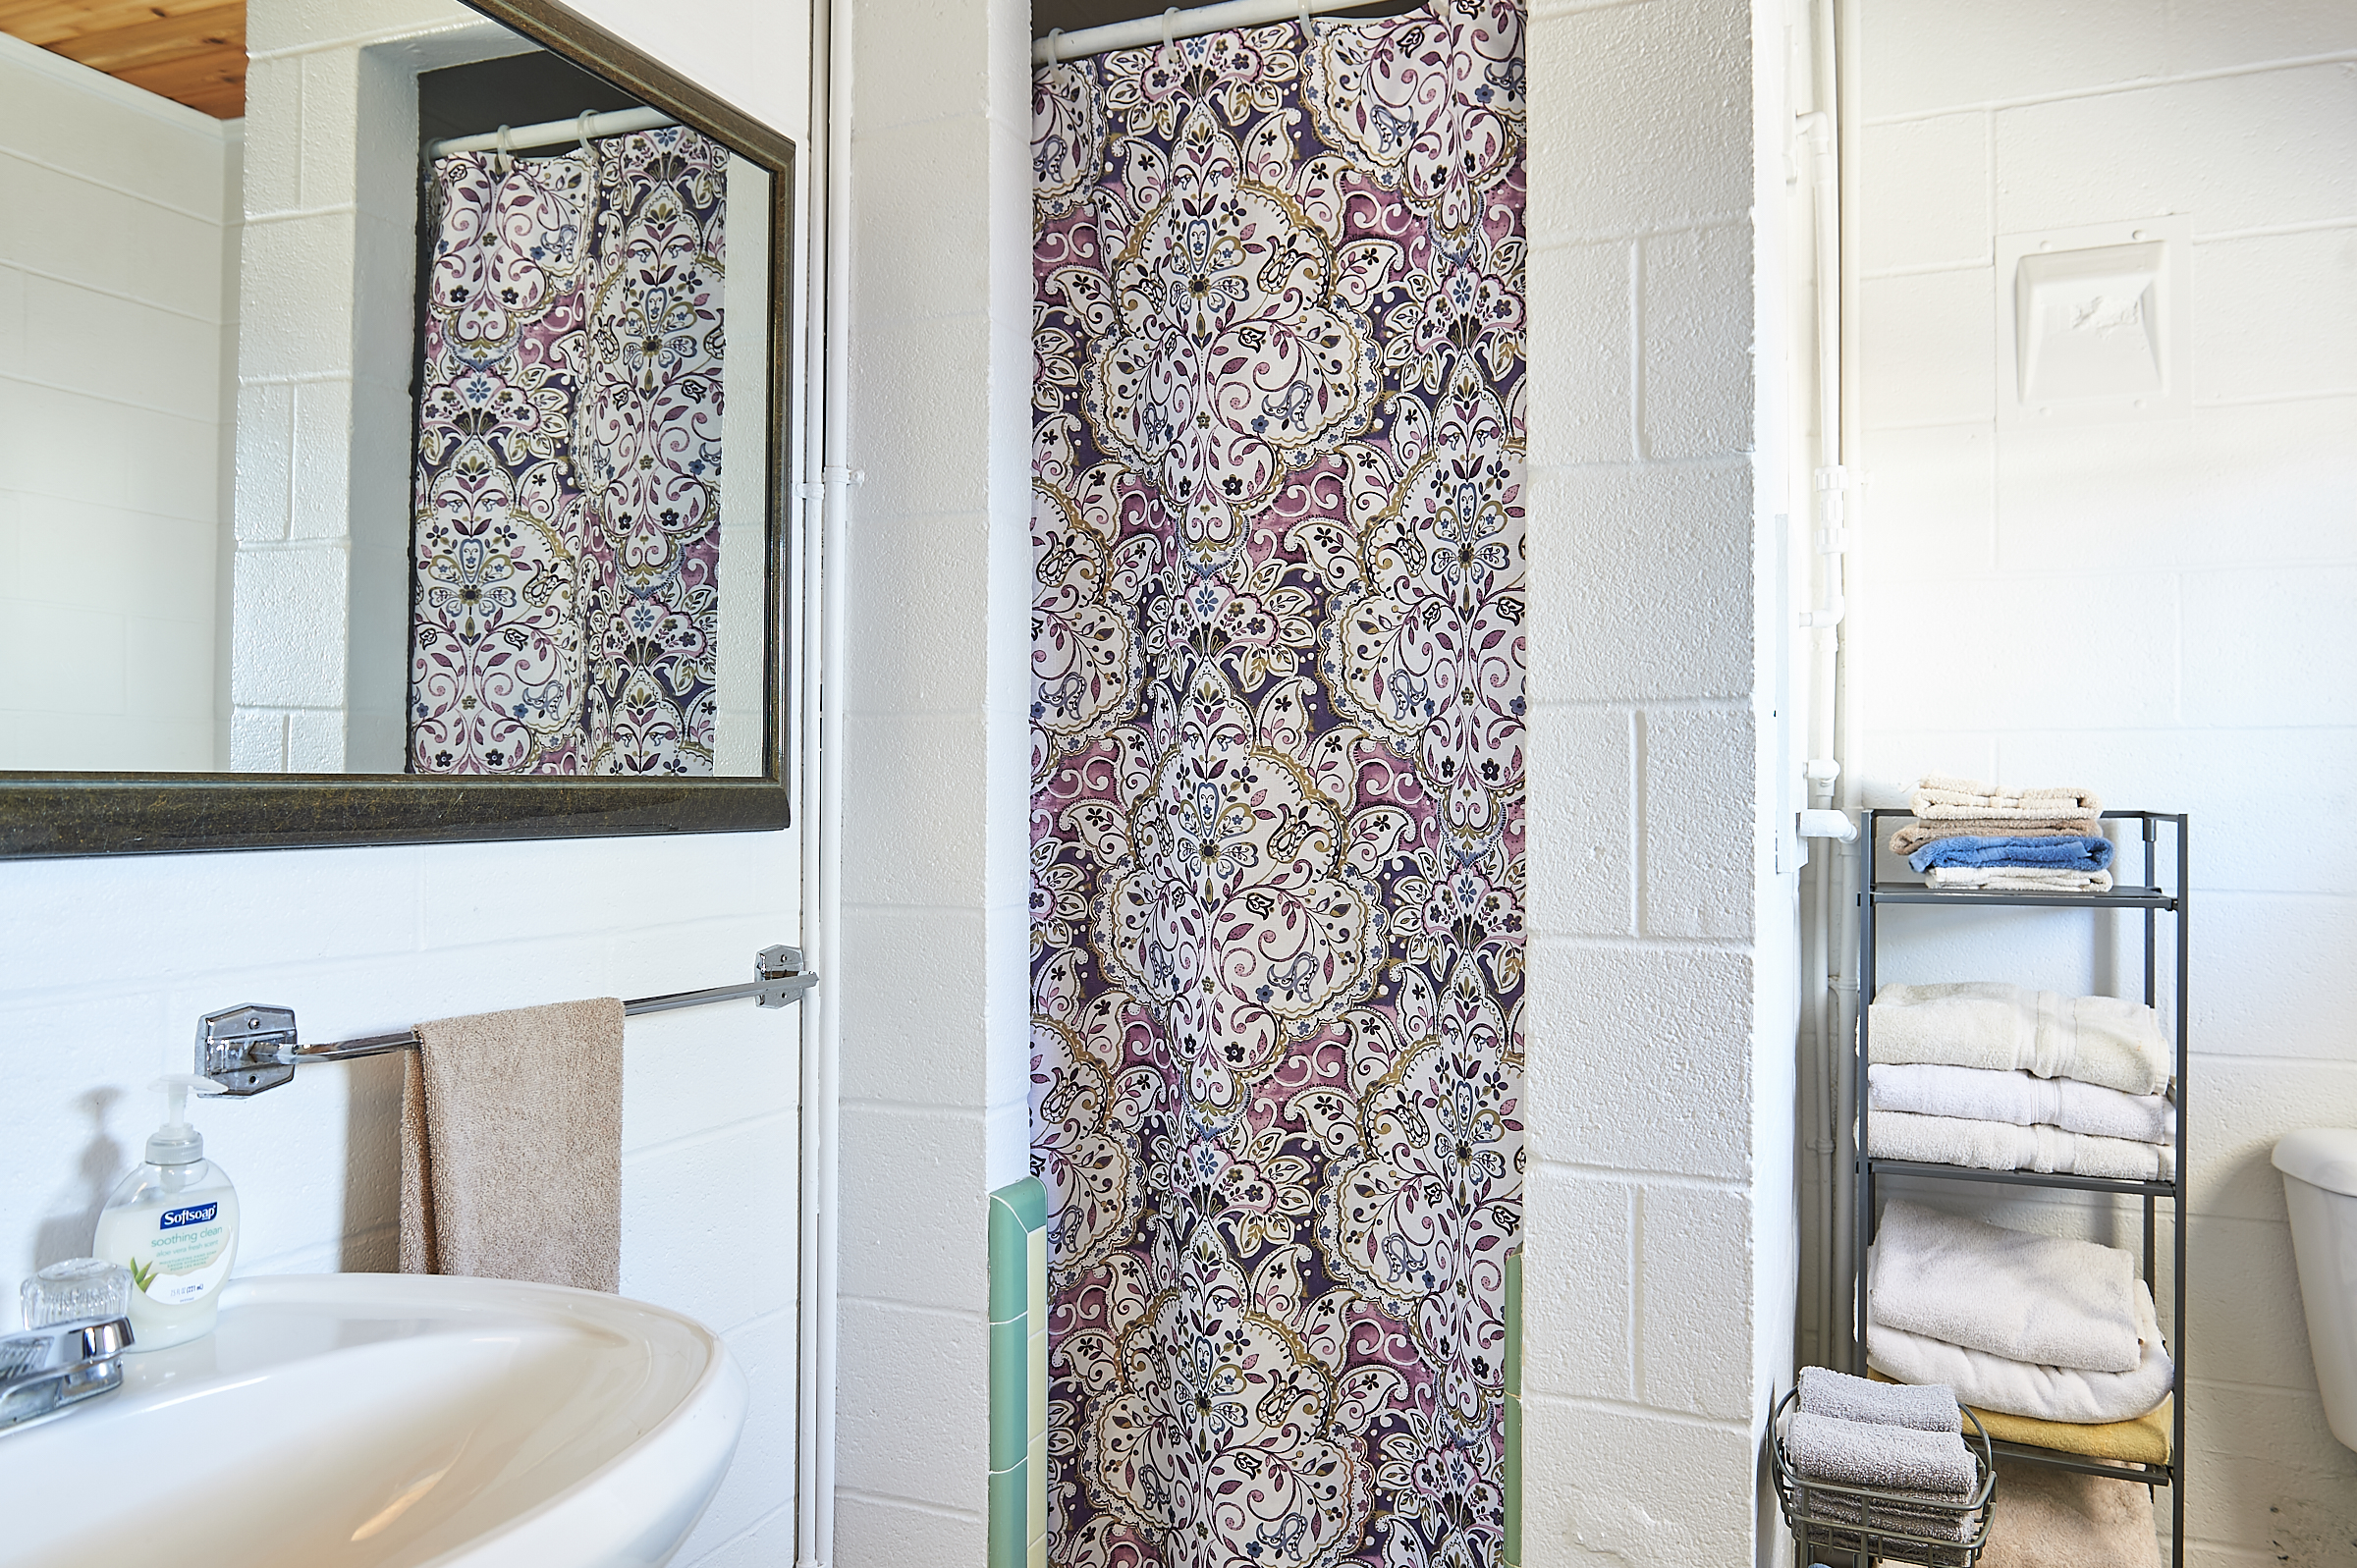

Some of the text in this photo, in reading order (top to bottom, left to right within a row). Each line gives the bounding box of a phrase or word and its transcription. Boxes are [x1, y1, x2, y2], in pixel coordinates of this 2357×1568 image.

[163, 1206, 215, 1225] Softsoap
[151, 1226, 223, 1248] soothing clean
